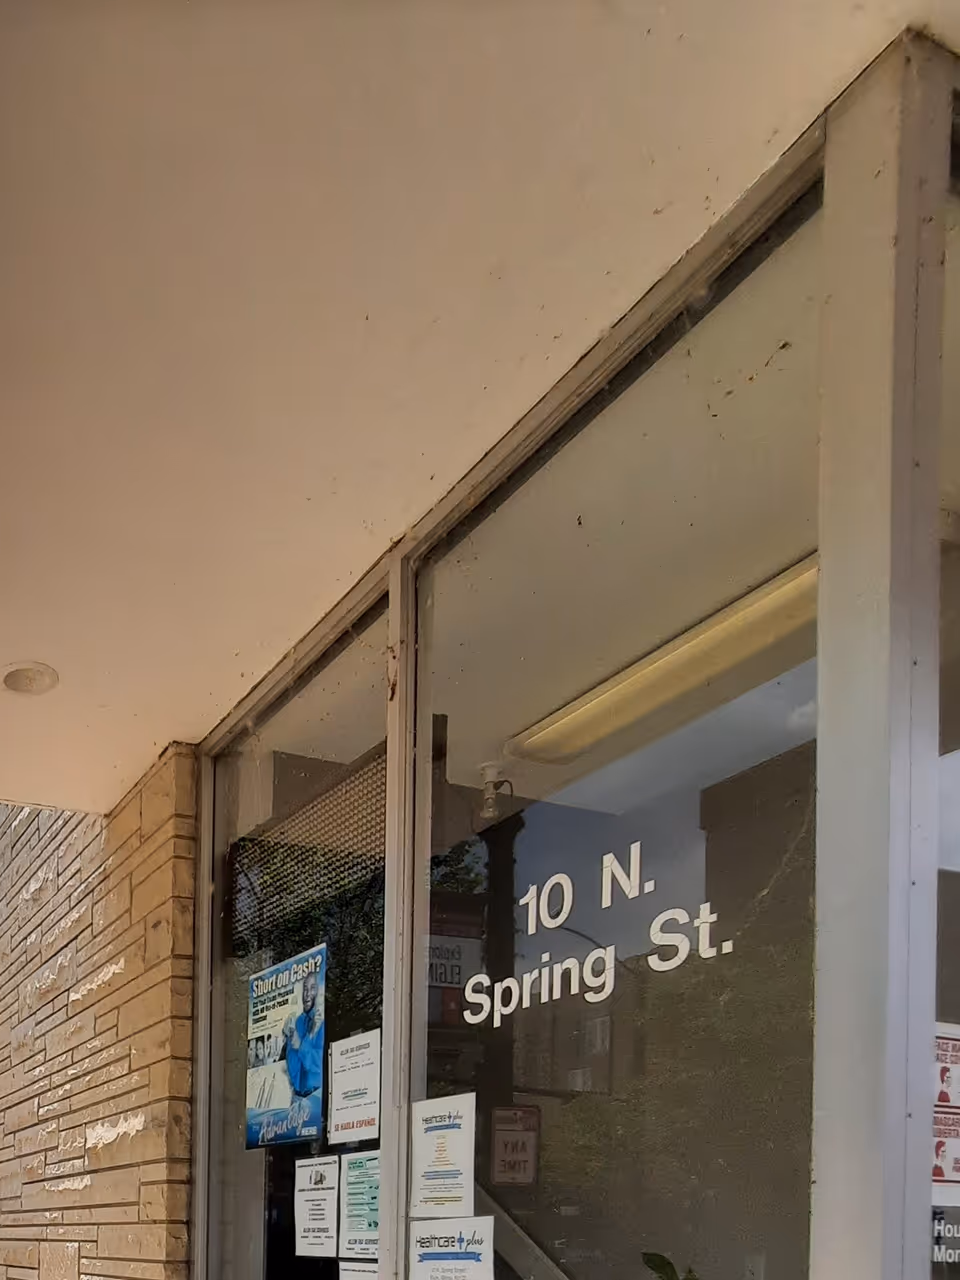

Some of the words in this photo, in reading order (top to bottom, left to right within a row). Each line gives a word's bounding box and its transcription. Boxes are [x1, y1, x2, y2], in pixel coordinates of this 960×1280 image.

[518, 873, 573, 936] 10
[601, 840, 656, 909] N.
[252, 974, 277, 998] Short
[277, 970, 290, 988] on
[290, 954, 322, 983] Cash?
[462, 944, 616, 1028] Spring
[646, 901, 734, 972] St.
[415, 1233, 456, 1249] Healthcare
[464, 1230, 485, 1253] plus
